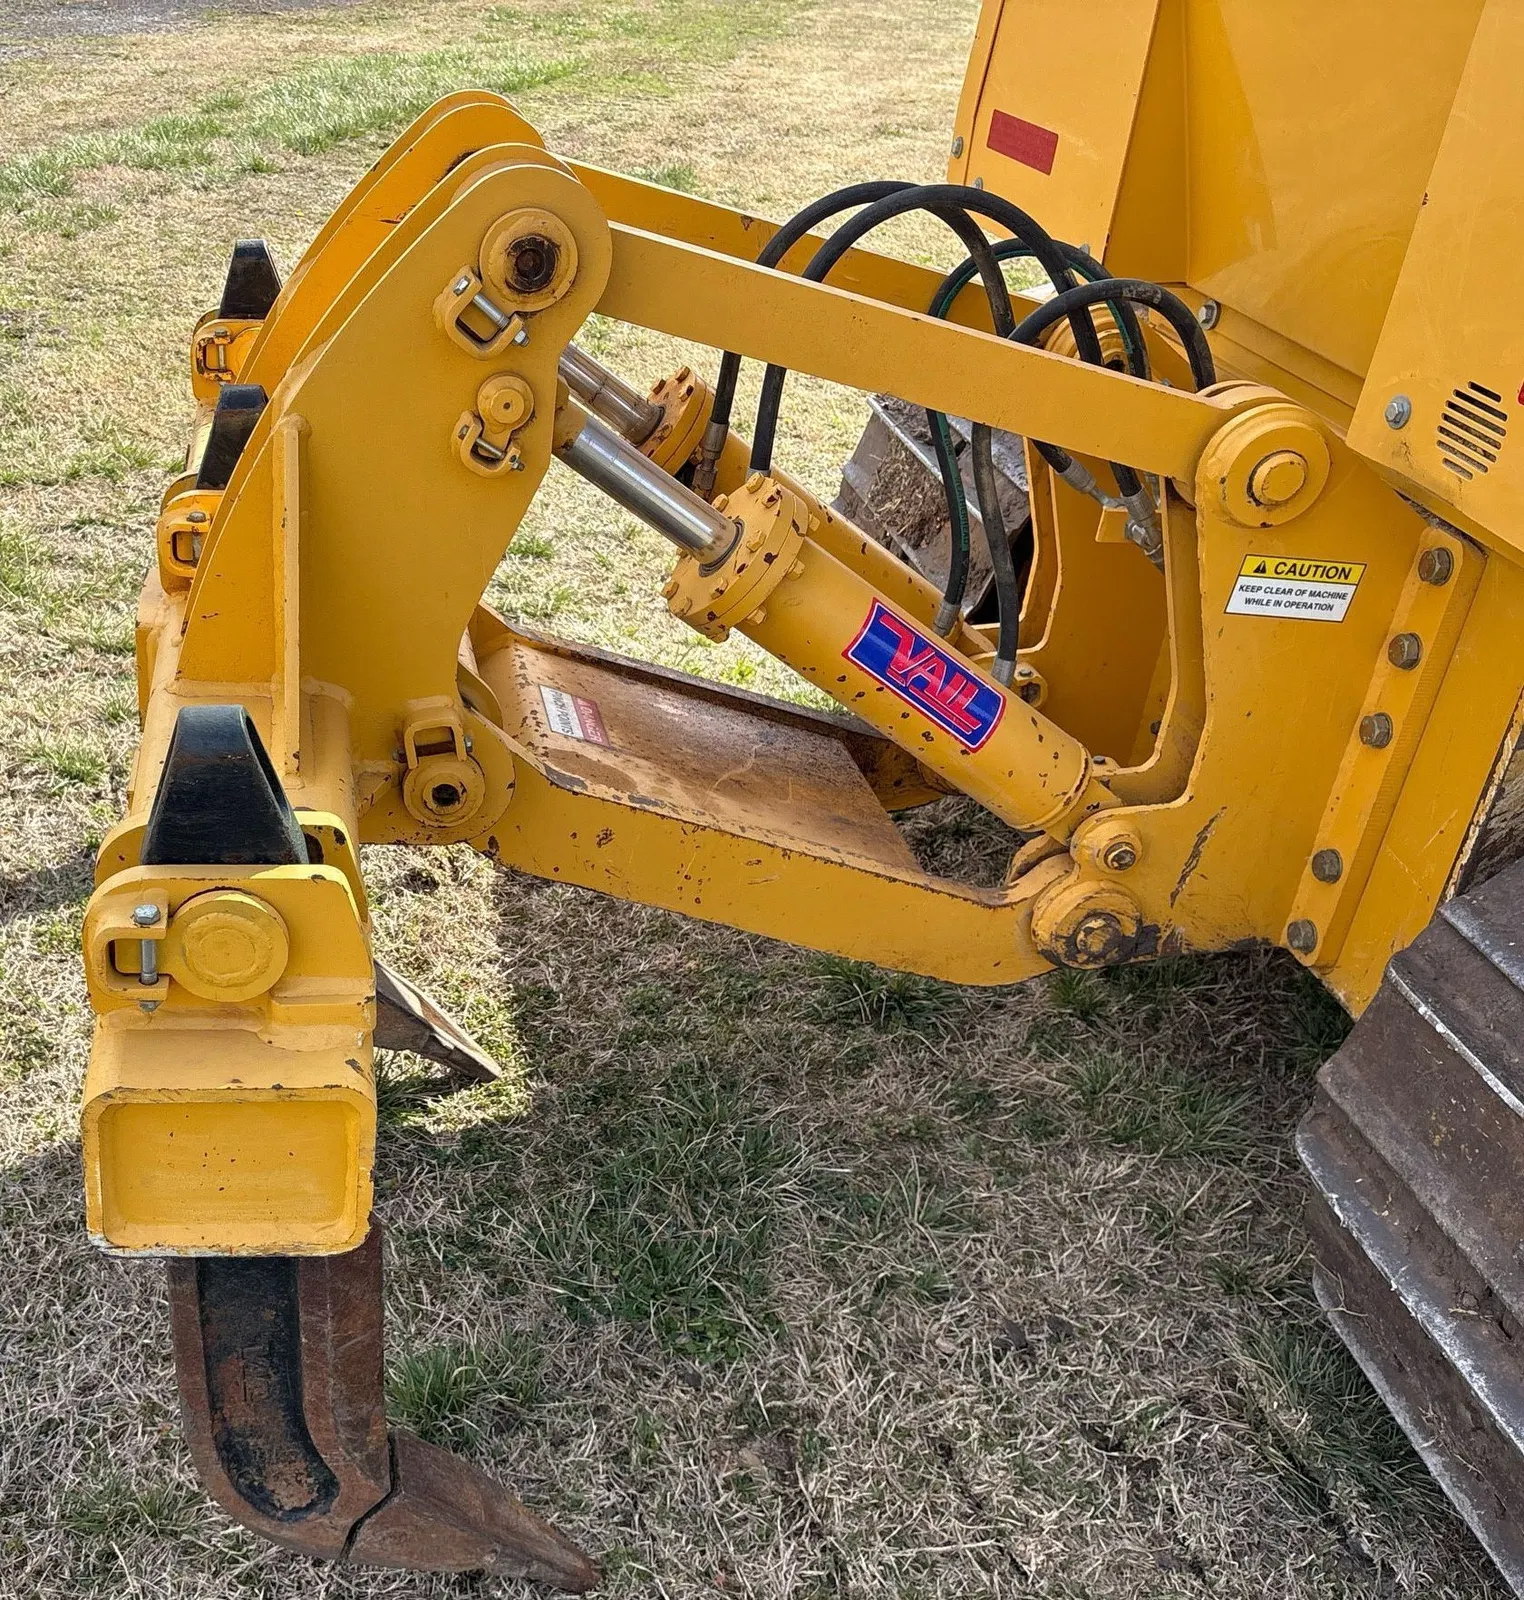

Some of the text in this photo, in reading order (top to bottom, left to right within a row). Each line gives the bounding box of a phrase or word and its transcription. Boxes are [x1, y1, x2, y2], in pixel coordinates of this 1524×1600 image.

[1274, 561, 1352, 580] CAUTION
[1238, 584, 1348, 600] KEEP CLEAR OF MACHINE
[1244, 597, 1334, 611] WHILE IN OPERATION
[879, 613, 982, 735] VAIL
[579, 706, 603, 742] DANGER
